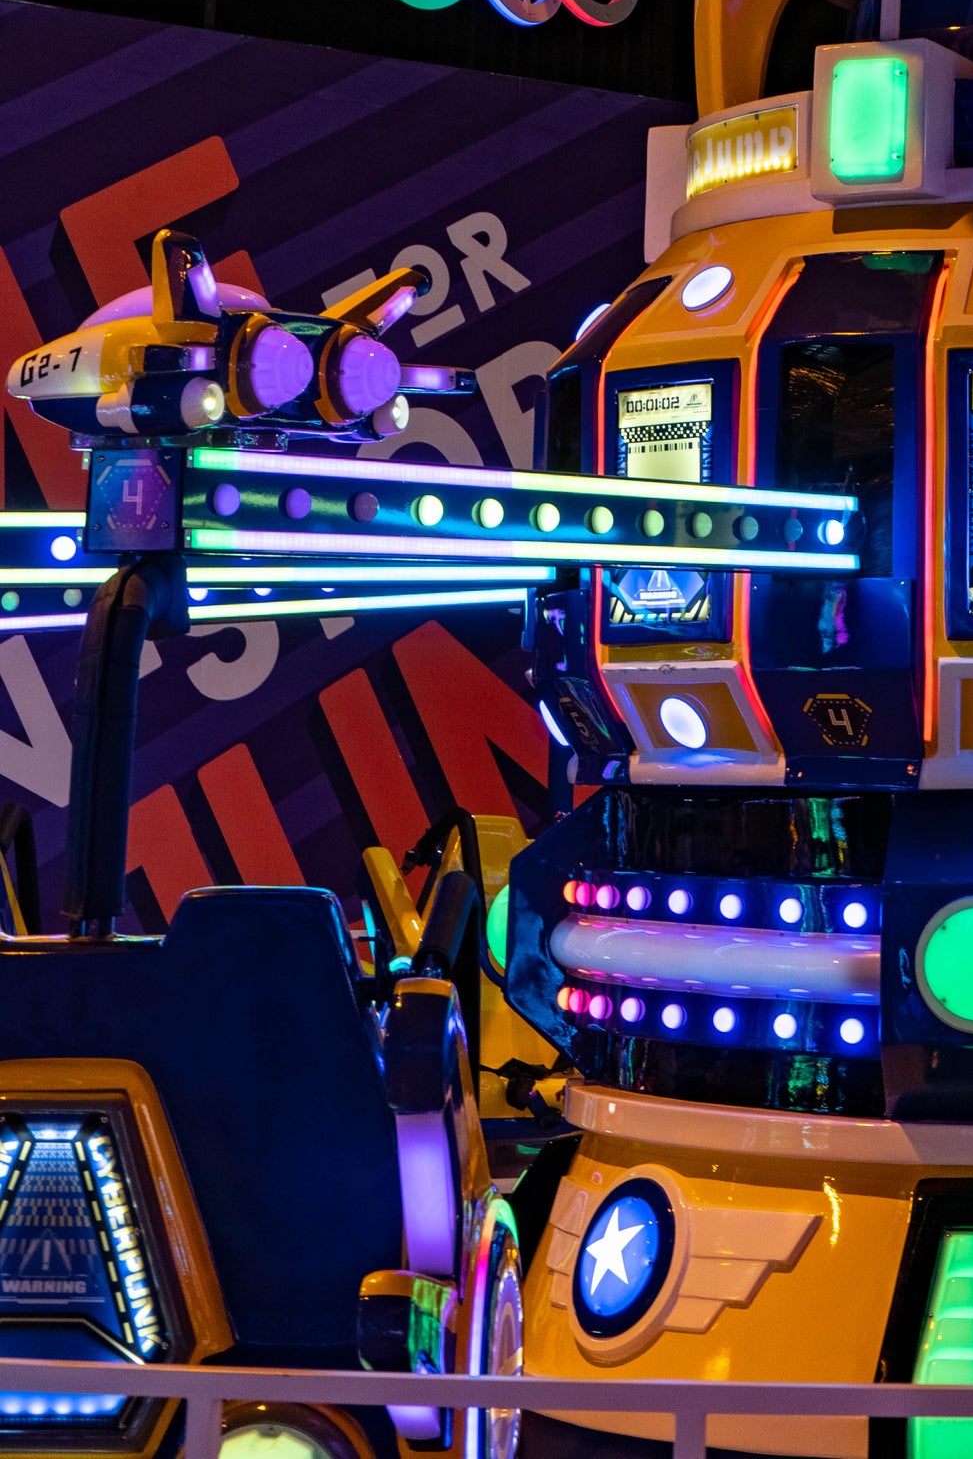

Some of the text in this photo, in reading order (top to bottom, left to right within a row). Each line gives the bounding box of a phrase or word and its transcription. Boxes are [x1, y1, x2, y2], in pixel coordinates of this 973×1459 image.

[20, 346, 82, 387] G2-7
[626, 396, 680, 414] 00:01:02
[123, 480, 143, 515] 4
[828, 709, 853, 735] 4
[88, 1136, 163, 1353] CYBERPUNK
[1, 1280, 87, 1293] WARNING
